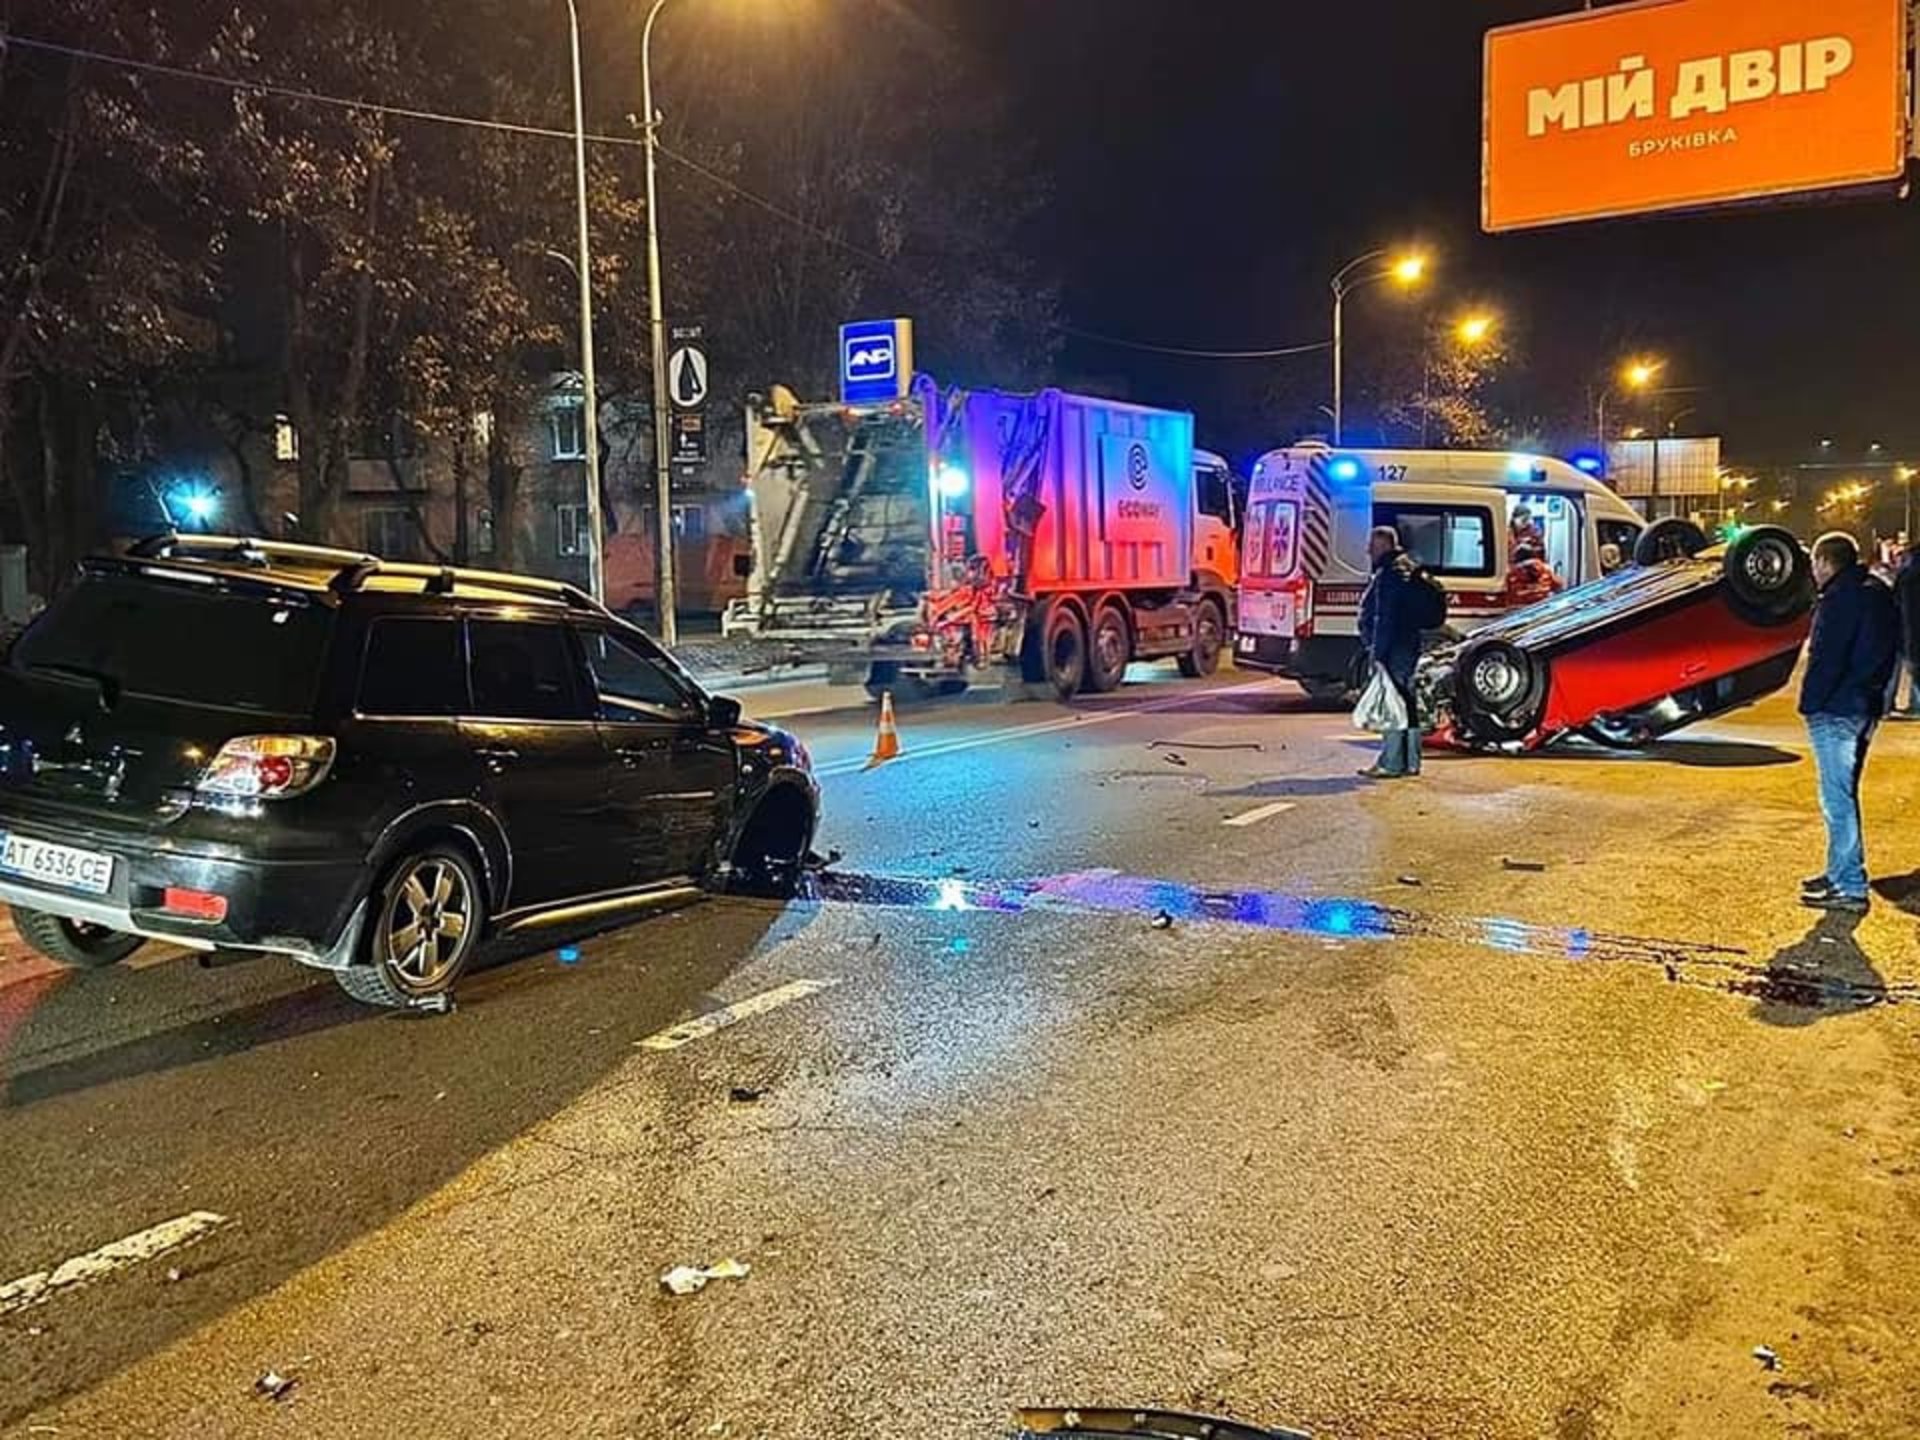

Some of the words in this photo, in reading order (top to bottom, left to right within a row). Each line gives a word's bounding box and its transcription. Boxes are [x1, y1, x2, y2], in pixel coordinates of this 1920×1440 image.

[1527, 56, 1654, 137] МІЙ
[1669, 36, 1854, 119] ДВІР
[1628, 127, 1738, 157] БРУКІВКА
[1378, 465, 1408, 481] 127
[6, 840, 31, 865] AT
[33, 847, 77, 877] 6536
[79, 858, 109, 884] CE
